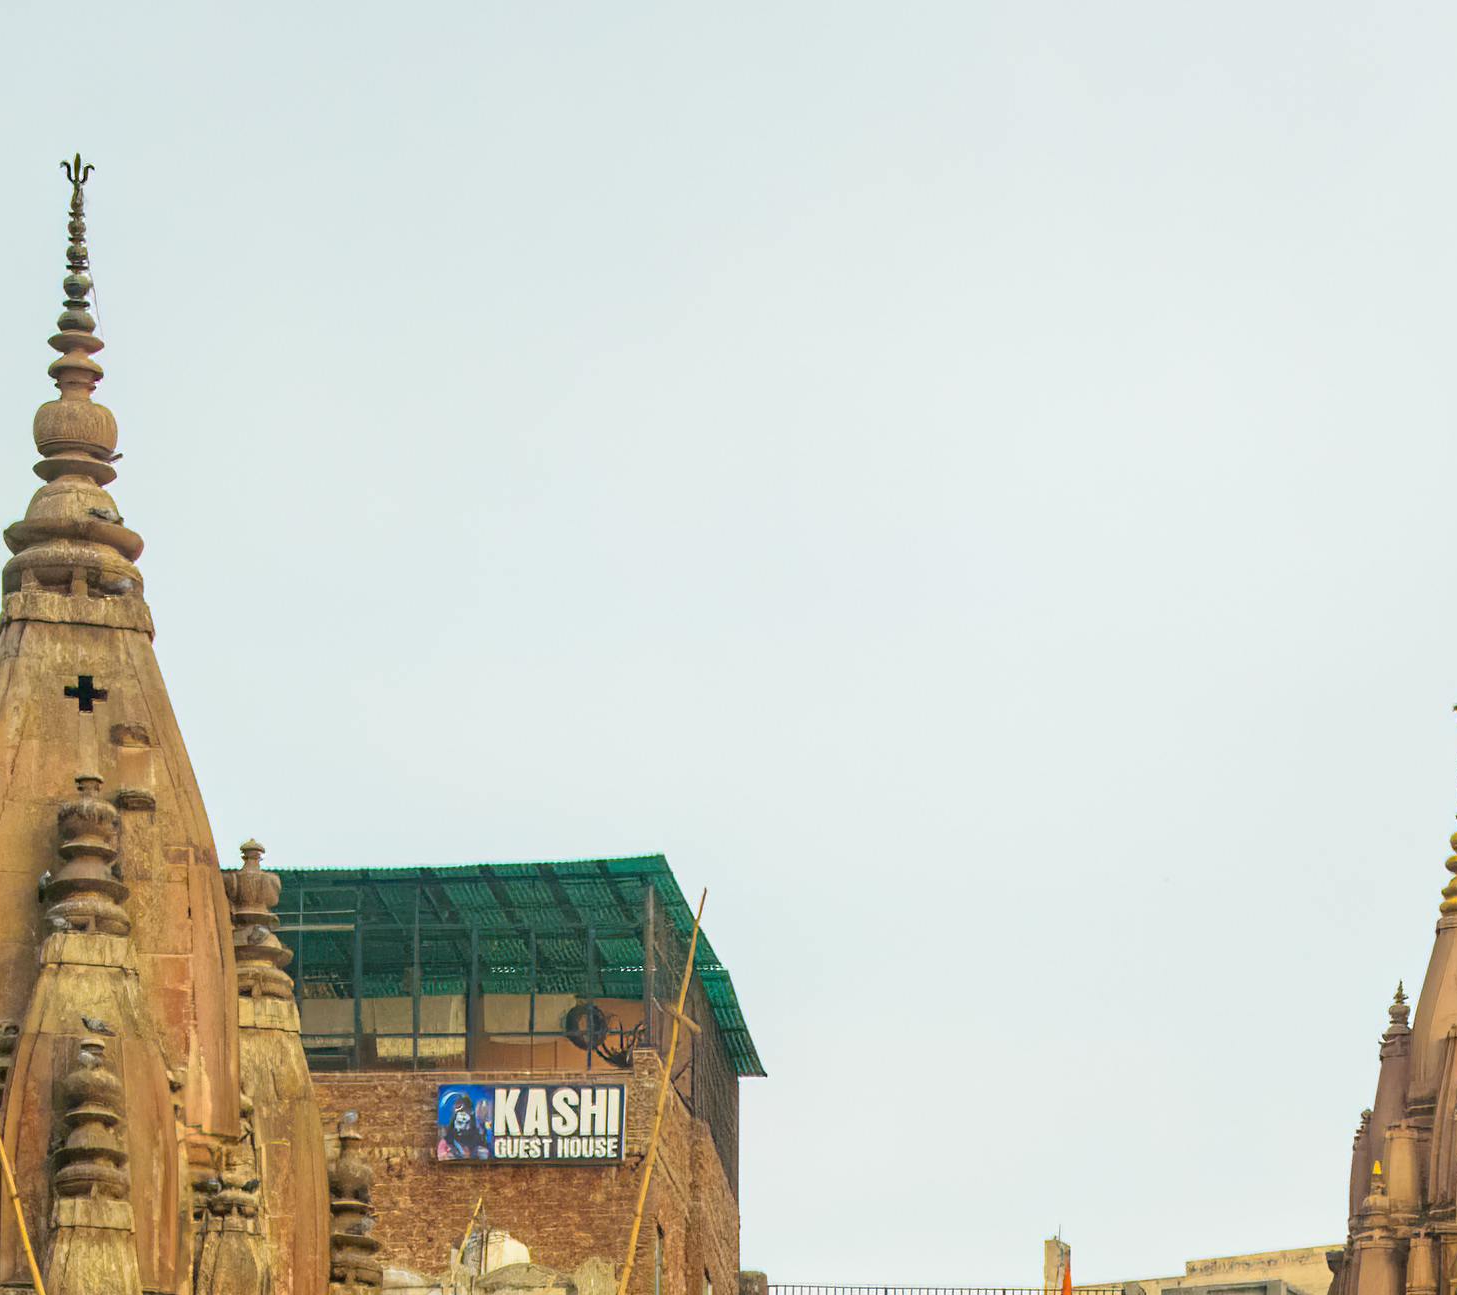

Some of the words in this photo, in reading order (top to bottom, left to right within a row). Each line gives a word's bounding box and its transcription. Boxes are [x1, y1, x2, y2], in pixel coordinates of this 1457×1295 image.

[494, 1088, 620, 1136] KASHI
[495, 1137, 552, 1158] GUEST
[557, 1137, 618, 1158] HOUSE
